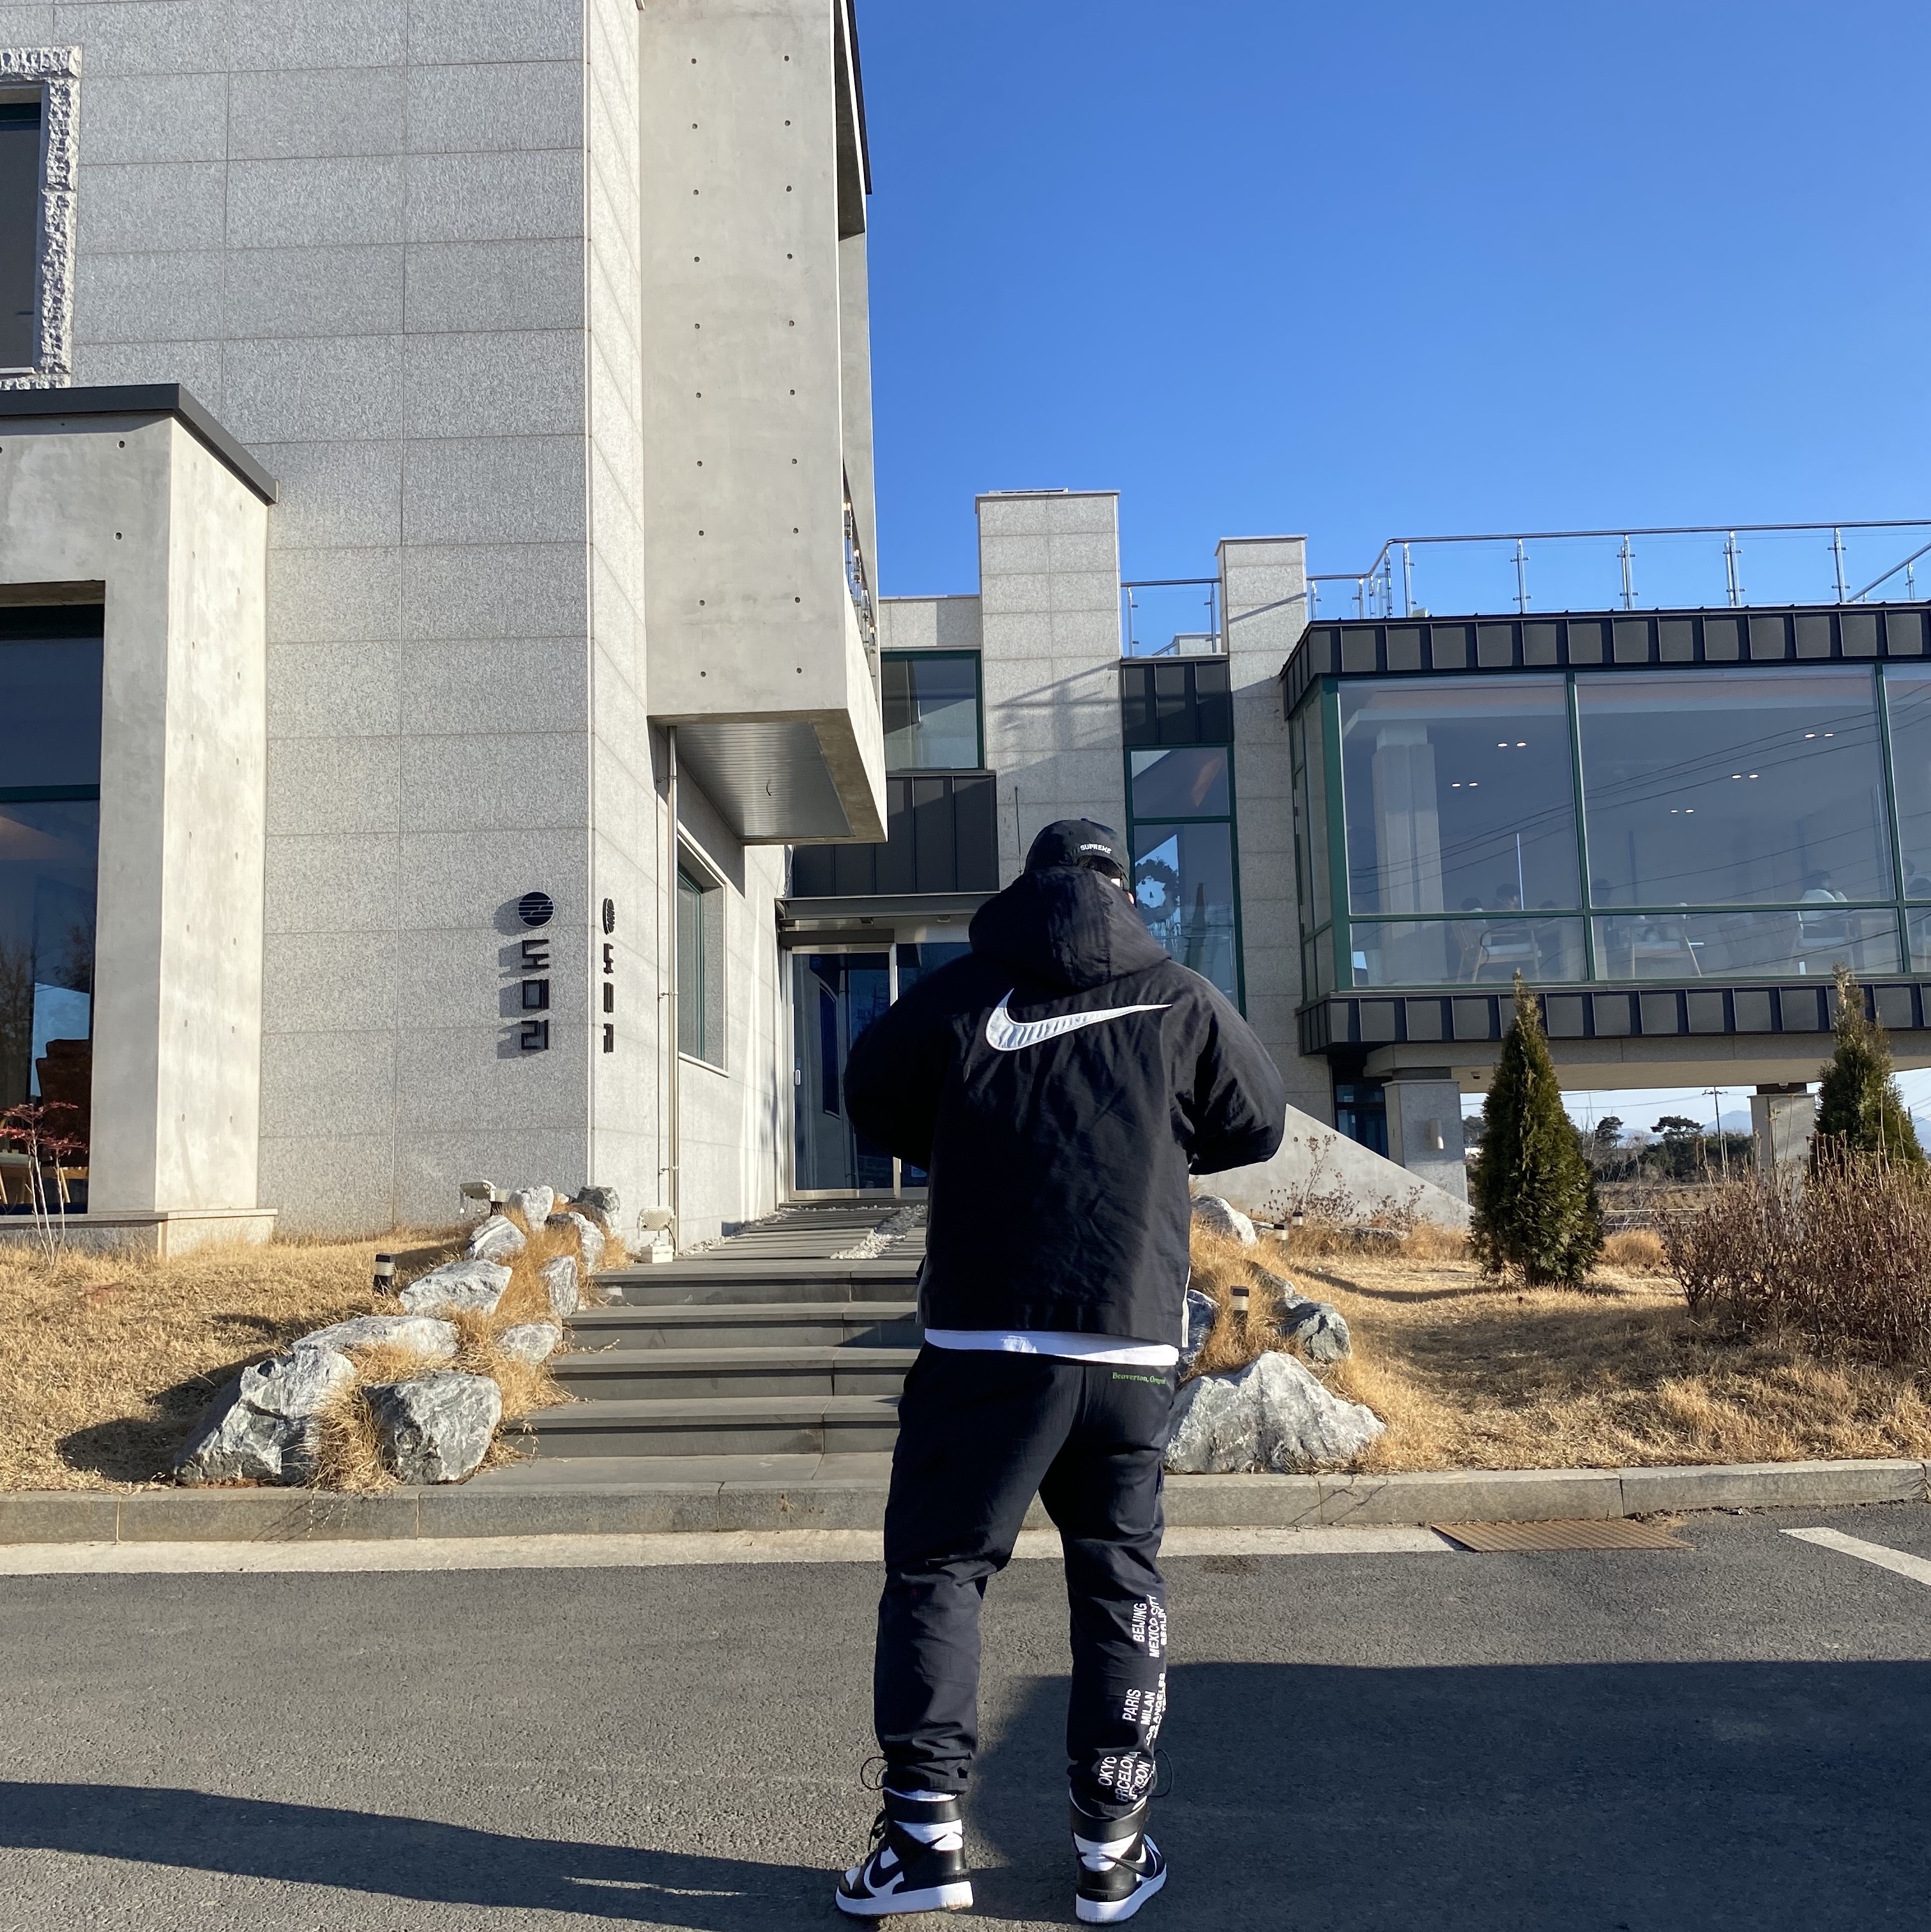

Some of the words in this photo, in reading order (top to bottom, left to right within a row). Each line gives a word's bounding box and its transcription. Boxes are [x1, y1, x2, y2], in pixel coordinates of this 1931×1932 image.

[1080, 844, 1112, 854] SUPREME
[1112, 1372, 1149, 1383] Beaverton,
[1132, 1603, 1147, 1642] BEIJING
[1148, 1617, 1160, 1658] MEXICO
[1122, 1689, 1142, 1722] PARIS
[1140, 1691, 1156, 1726] MILAN
[1098, 1756, 1117, 1786] OKYO
